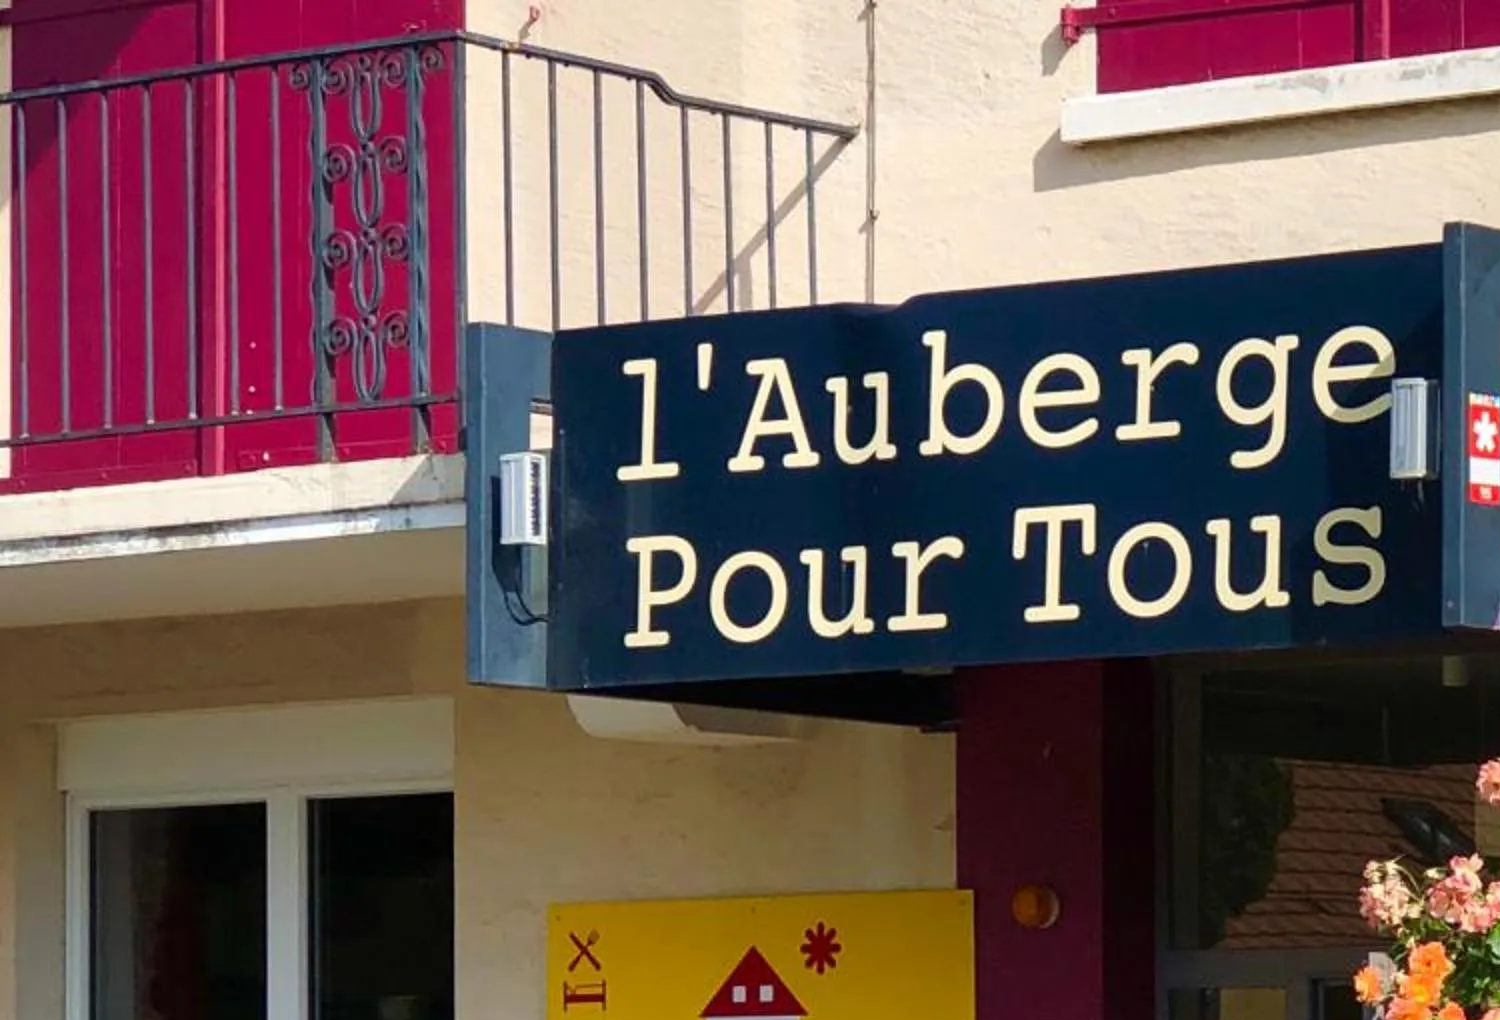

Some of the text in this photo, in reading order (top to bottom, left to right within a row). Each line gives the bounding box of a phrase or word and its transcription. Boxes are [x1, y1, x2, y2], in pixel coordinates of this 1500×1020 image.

[616, 323, 1397, 481] l'Auberge
[624, 504, 1384, 647] Pour Tous
